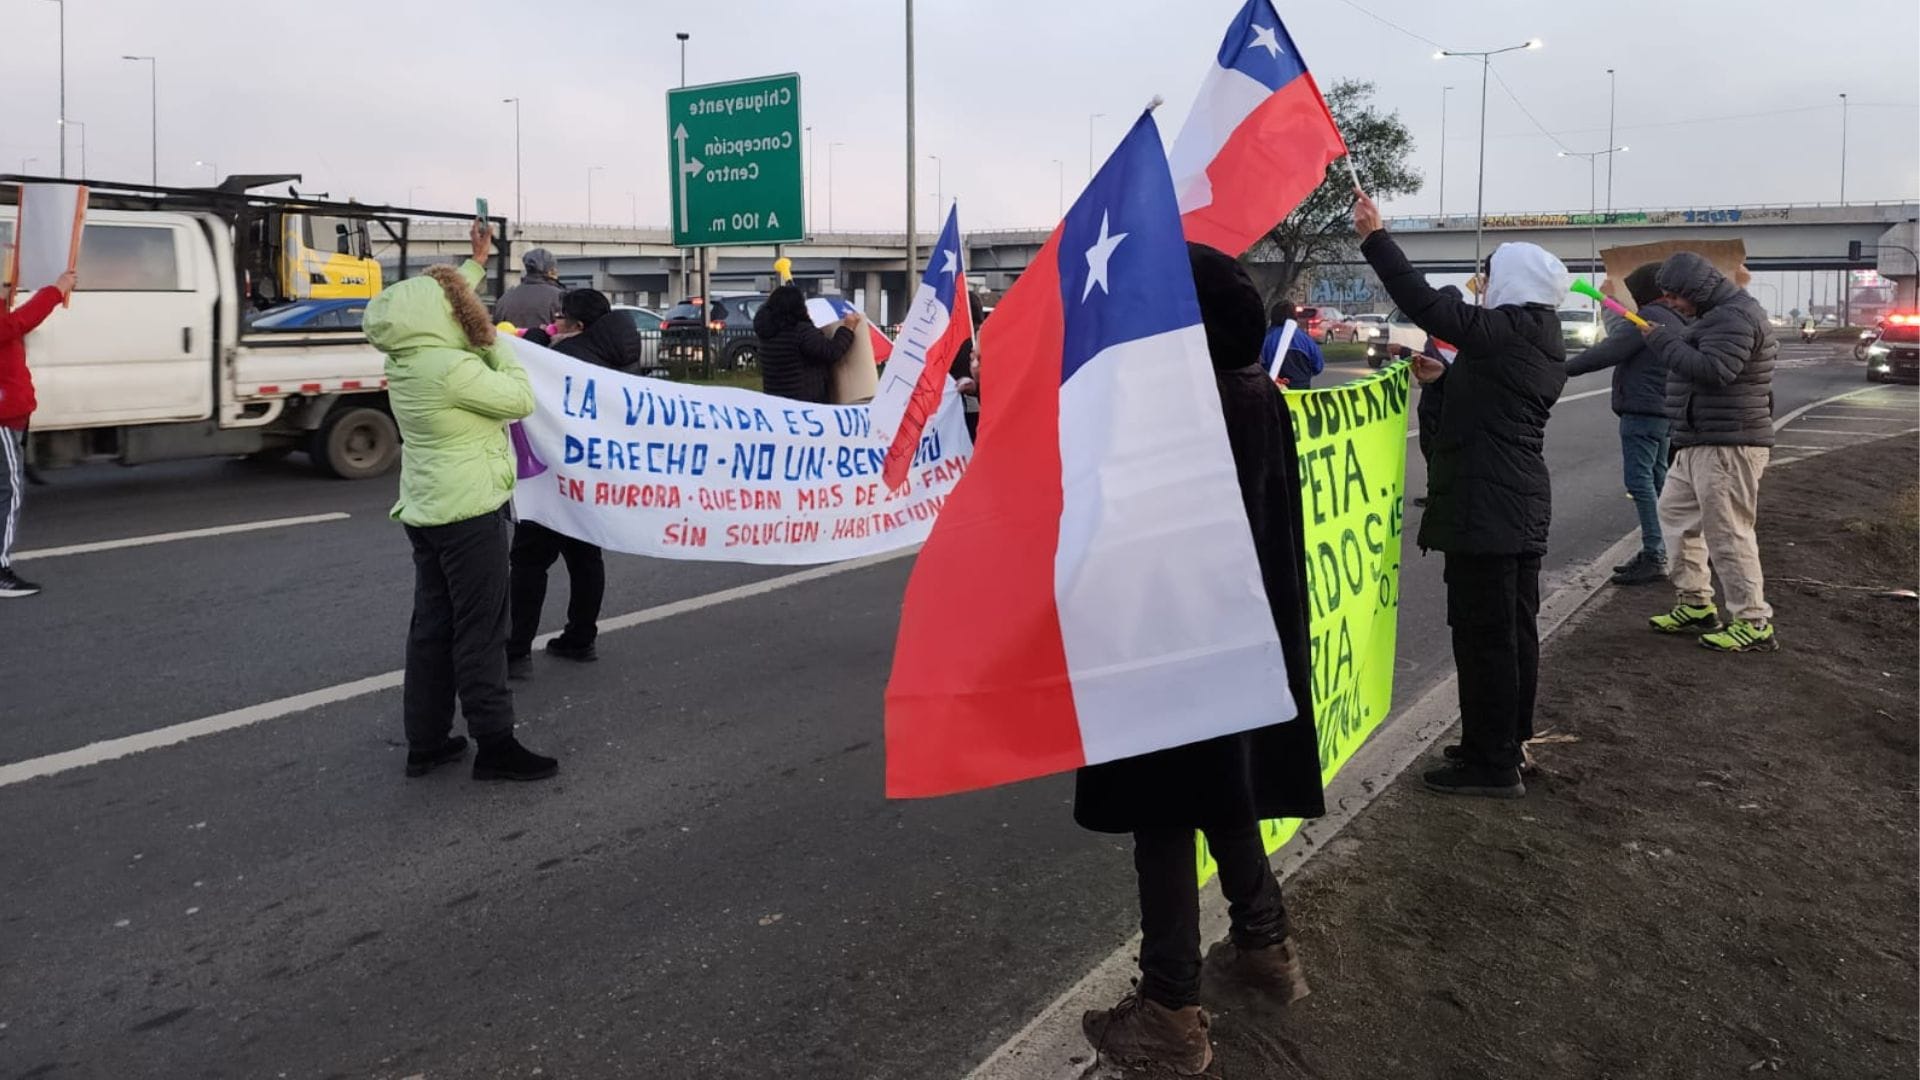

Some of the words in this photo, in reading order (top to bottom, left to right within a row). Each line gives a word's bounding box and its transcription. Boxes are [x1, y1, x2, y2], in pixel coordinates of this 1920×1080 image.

[563, 375, 597, 420] LA
[783, 409, 824, 437] ES
[833, 407, 871, 438] UN
[563, 434, 708, 476] DERECHO
[731, 442, 776, 481] NO
[784, 445, 826, 481] UN
[556, 474, 585, 502] EN
[594, 482, 681, 509] AURORA
[700, 486, 782, 511] QUEDAN
[798, 484, 844, 511] MAS
[855, 483, 879, 506] DE
[662, 516, 707, 547] SIN
